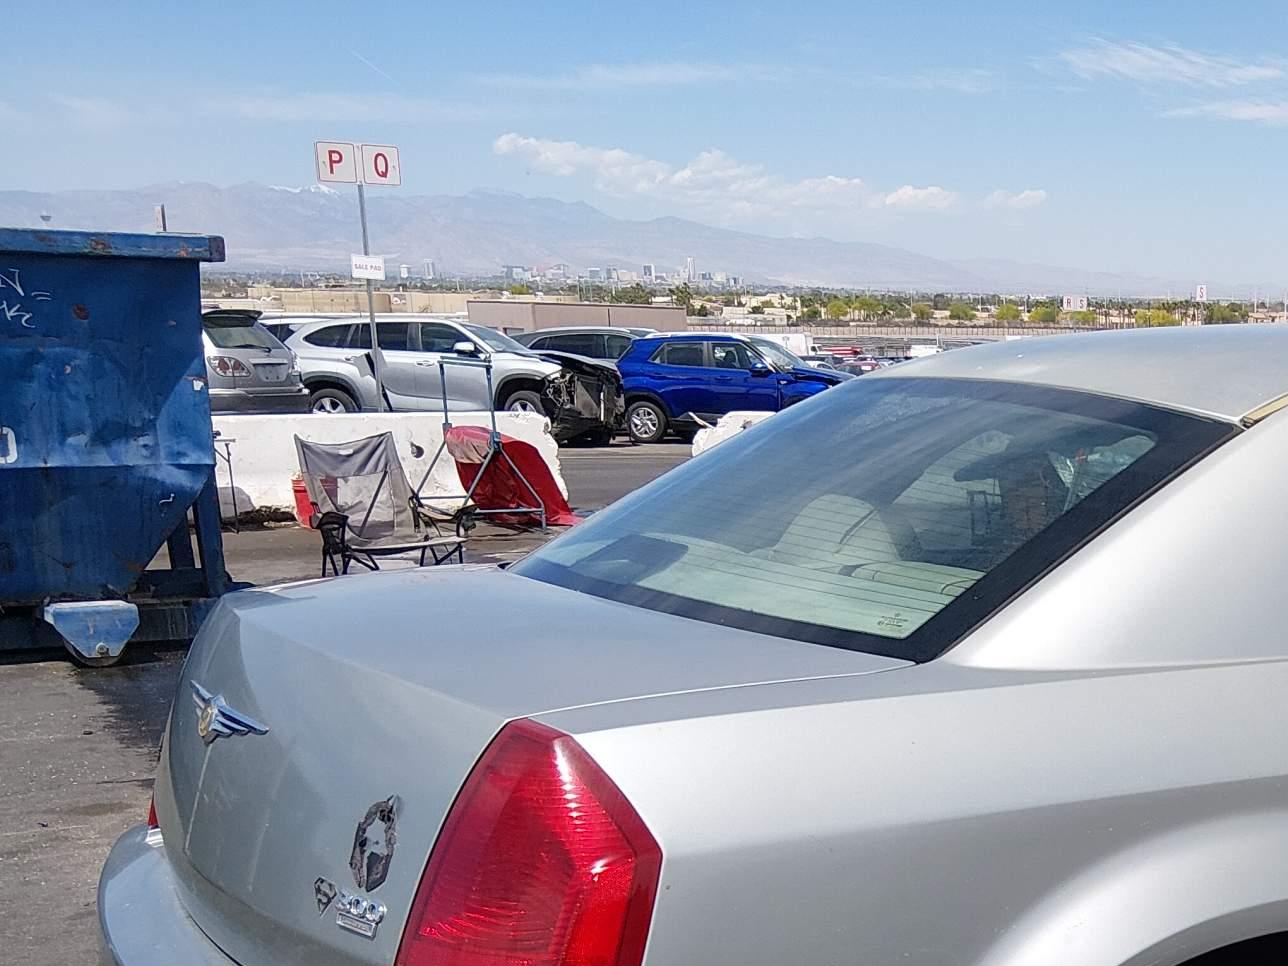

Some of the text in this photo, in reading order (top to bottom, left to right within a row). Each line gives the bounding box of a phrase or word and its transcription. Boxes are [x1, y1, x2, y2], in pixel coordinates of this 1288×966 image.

[328, 149, 343, 175] P
[374, 152, 389, 179] Q
[1199, 287, 1204, 298] S
